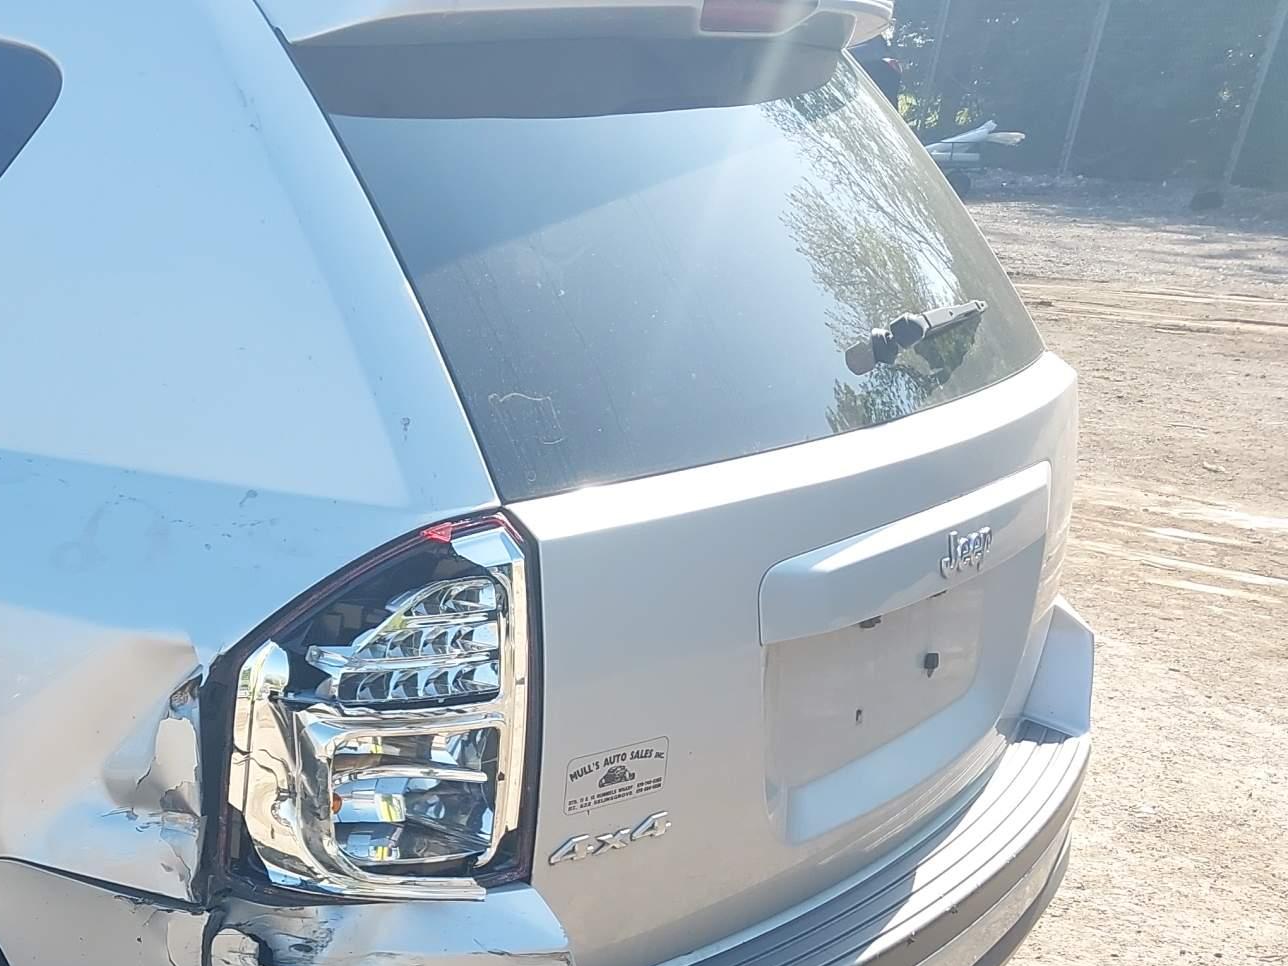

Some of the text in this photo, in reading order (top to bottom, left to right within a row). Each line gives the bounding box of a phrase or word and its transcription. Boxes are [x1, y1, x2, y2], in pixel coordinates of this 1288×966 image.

[939, 526, 993, 580] Jeep
[569, 760, 601, 782] MULL'S
[603, 752, 627, 768] AUTO
[630, 748, 654, 761] SALES
